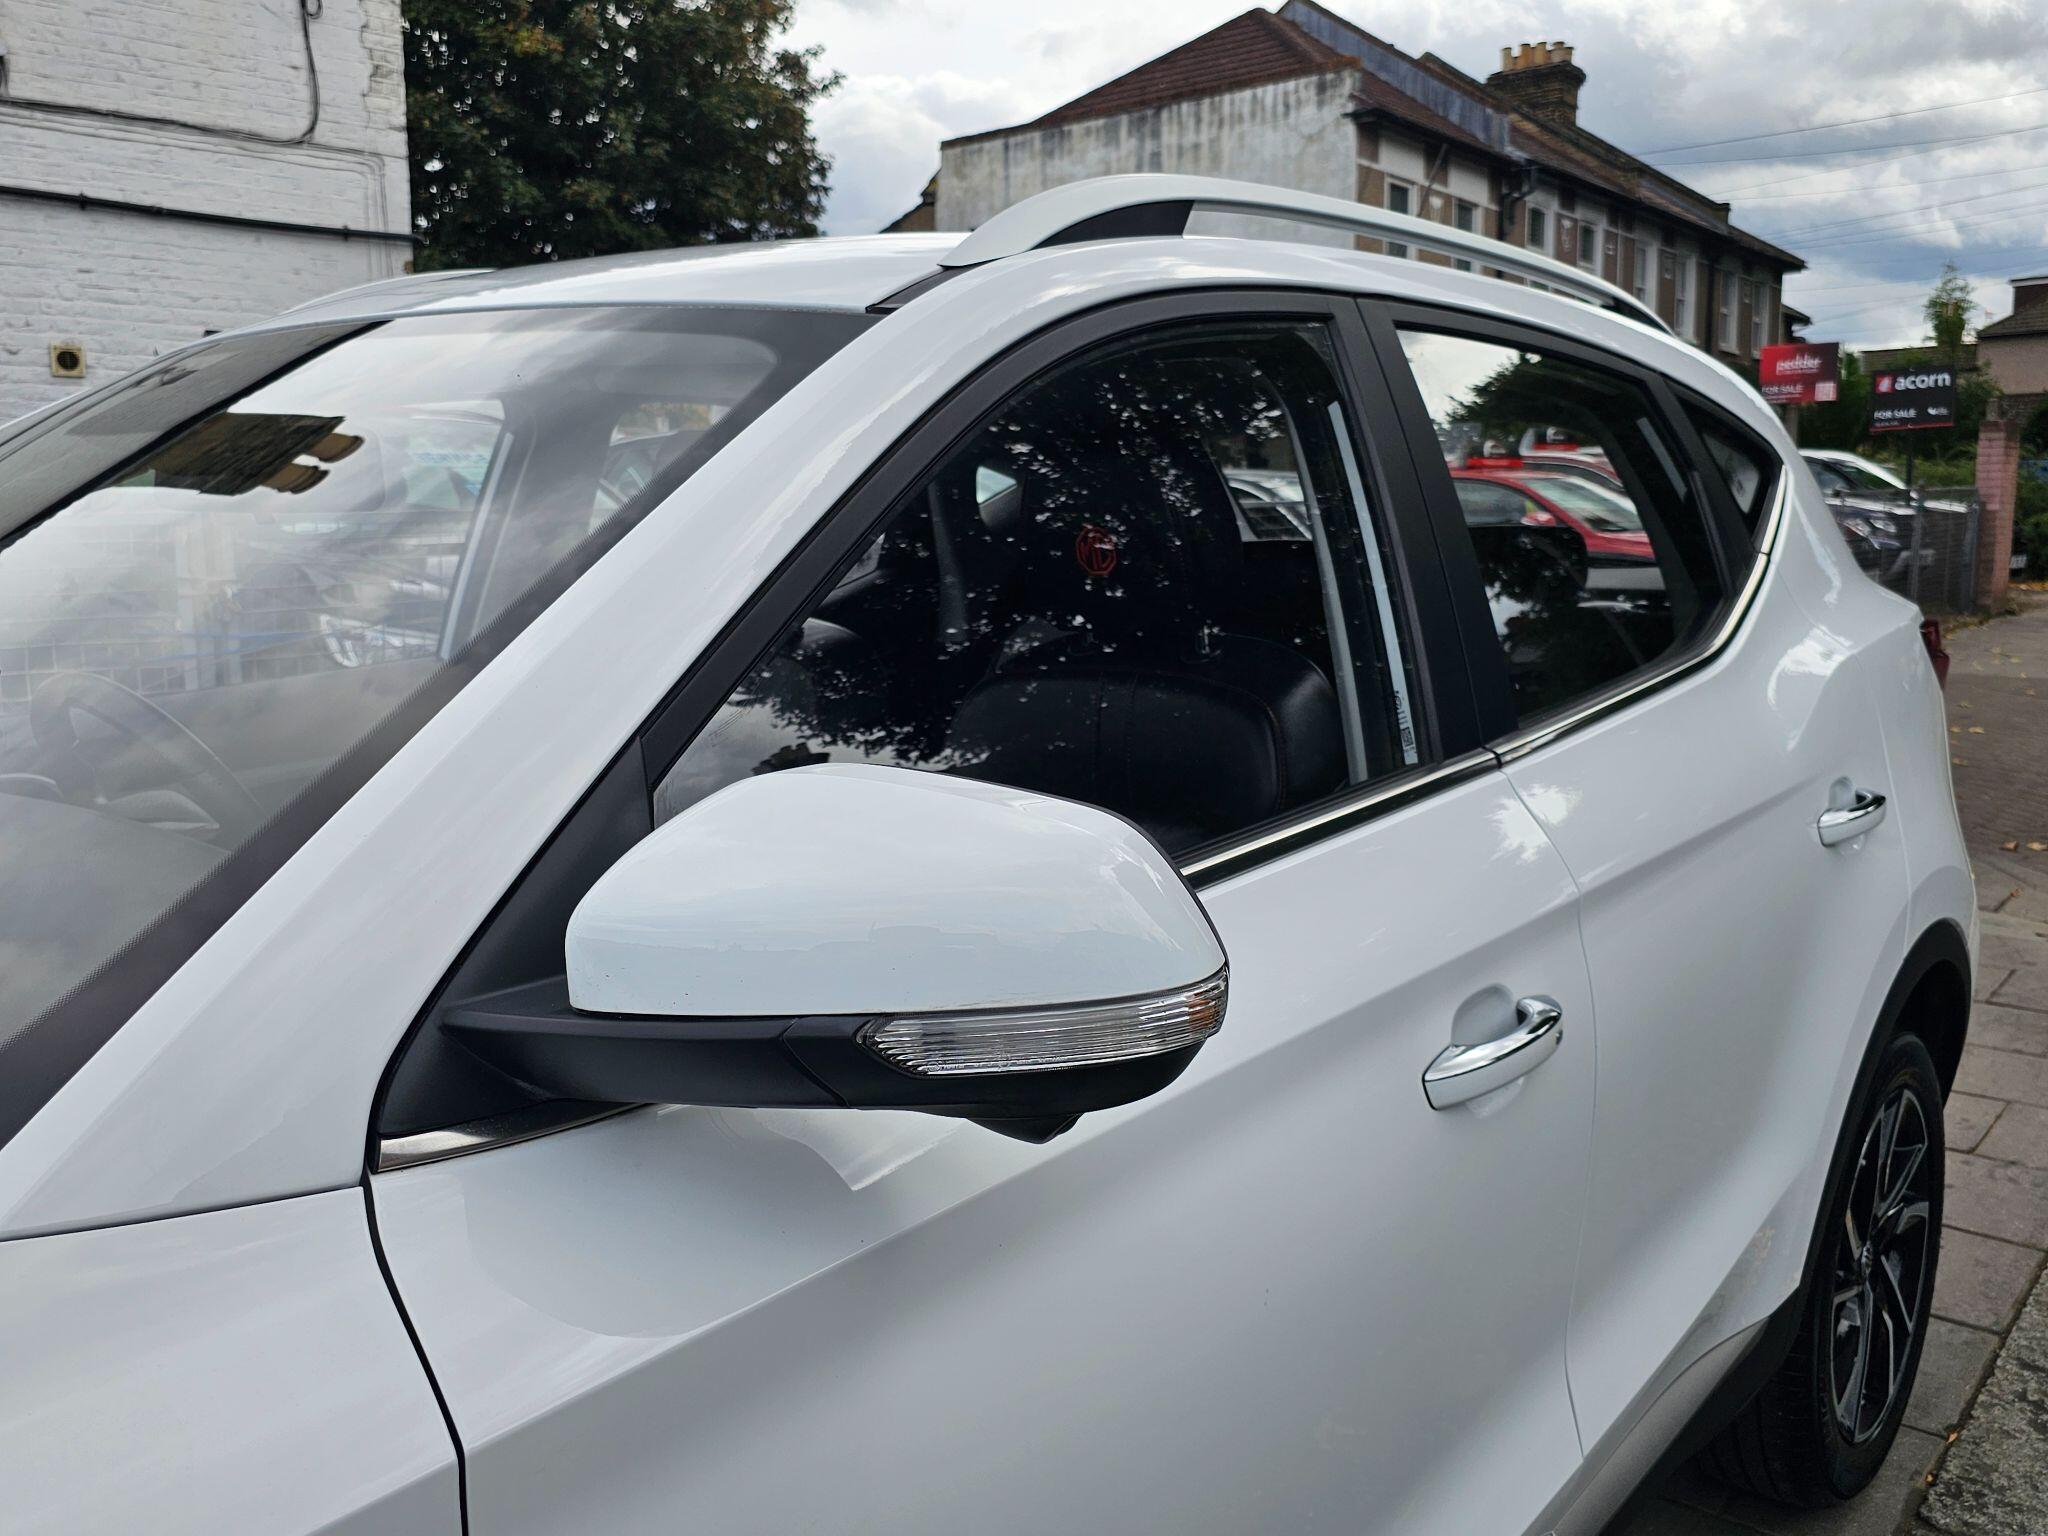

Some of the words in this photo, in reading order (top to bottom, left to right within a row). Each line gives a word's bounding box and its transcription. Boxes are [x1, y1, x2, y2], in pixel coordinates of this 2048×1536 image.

[1776, 353, 1822, 375] pedder
[1780, 383, 1805, 394] SALE
[1894, 372, 1952, 391] acorn
[1873, 410, 1892, 419] FOR
[1893, 408, 1917, 418] SALE
